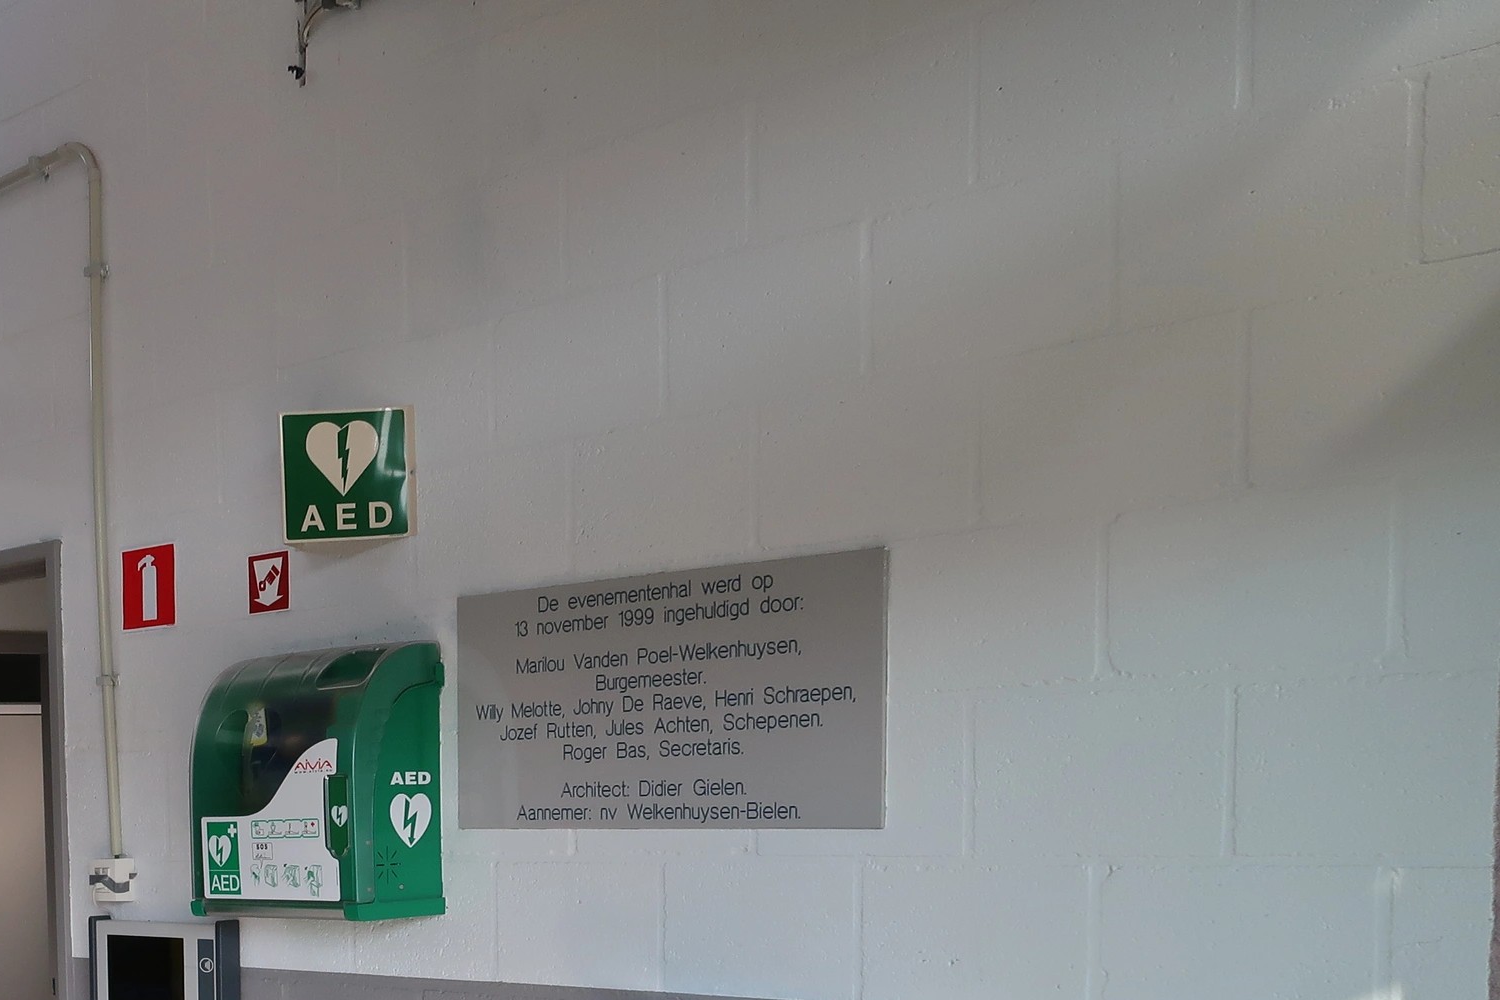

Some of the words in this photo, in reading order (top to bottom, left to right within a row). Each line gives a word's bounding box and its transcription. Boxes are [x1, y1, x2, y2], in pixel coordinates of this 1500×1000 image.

[301, 500, 393, 533] AED
[538, 596, 559, 613] De
[568, 580, 691, 610] evenementenhal
[701, 574, 741, 595] werd
[752, 575, 773, 593] op
[515, 621, 528, 637] 13
[537, 615, 609, 635] november
[619, 607, 654, 627] 1999
[664, 598, 749, 625] ingehuldigd
[760, 596, 804, 614] door:
[516, 657, 564, 674] Marilou
[574, 651, 628, 670] Vanden
[638, 639, 801, 665] Poel-Welkenhuysen,
[596, 669, 707, 693] Burgemeester.
[476, 704, 503, 723] Willy
[512, 701, 565, 719] Melotte,
[573, 698, 614, 717] Johny
[623, 696, 644, 713] De
[653, 692, 706, 711] Raeve,
[715, 688, 754, 707] Henri
[764, 685, 856, 705] Schraepen,
[500, 723, 538, 741] Jozef
[547, 722, 596, 739] Rutten,
[606, 719, 644, 736] Jules
[654, 715, 713, 735] Achten,
[723, 712, 823, 733] Schepenen.
[563, 743, 607, 763] Roger
[617, 742, 649, 760] Bas,
[659, 738, 744, 757] Secretaris.
[390, 770, 432, 786] AED
[561, 780, 630, 798] Architect:
[639, 780, 683, 797] Didier
[693, 778, 747, 796] Gielen.
[517, 804, 591, 820] Aannemer:
[601, 807, 617, 820] nv
[627, 802, 801, 823] Welkenhuysen-Bielen.
[211, 873, 241, 893] AED
